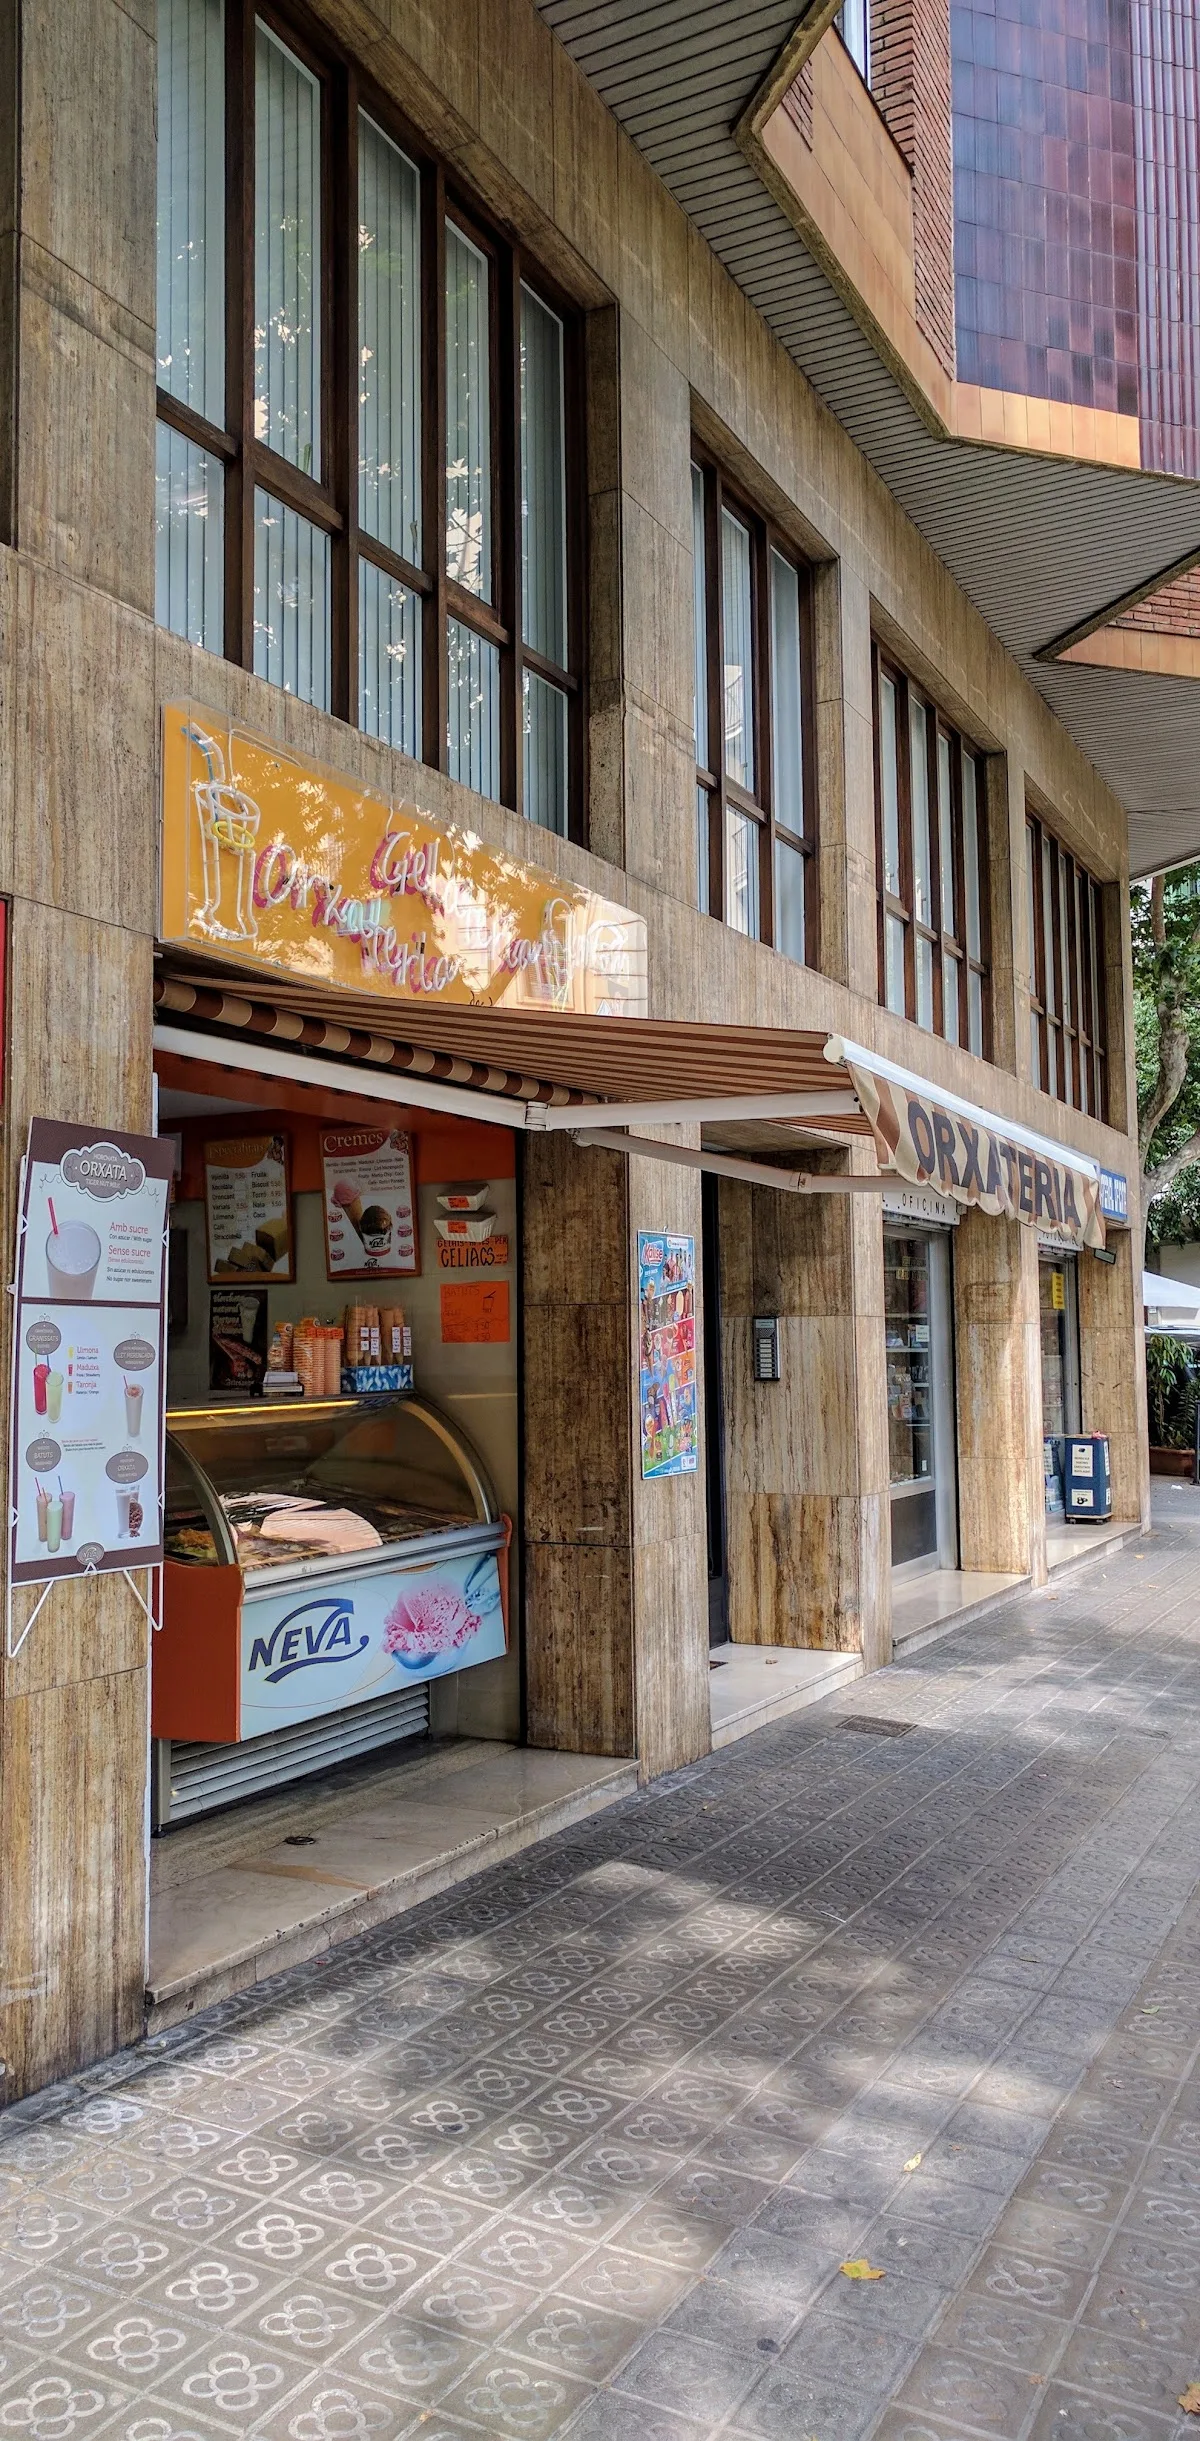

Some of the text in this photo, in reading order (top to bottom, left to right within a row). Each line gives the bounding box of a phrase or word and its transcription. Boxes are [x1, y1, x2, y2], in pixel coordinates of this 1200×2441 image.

[324, 1132, 383, 1153] Cremes
[80, 1160, 127, 1181] ORXATA
[908, 1100, 1081, 1228] ORXATERIA
[902, 1193, 947, 1216] OFICINA
[110, 1222, 148, 1234] Amb sucre
[108, 1244, 151, 1257] Sense sucre
[441, 1247, 495, 1268] CELIACS
[248, 1598, 357, 1673] NEVA
